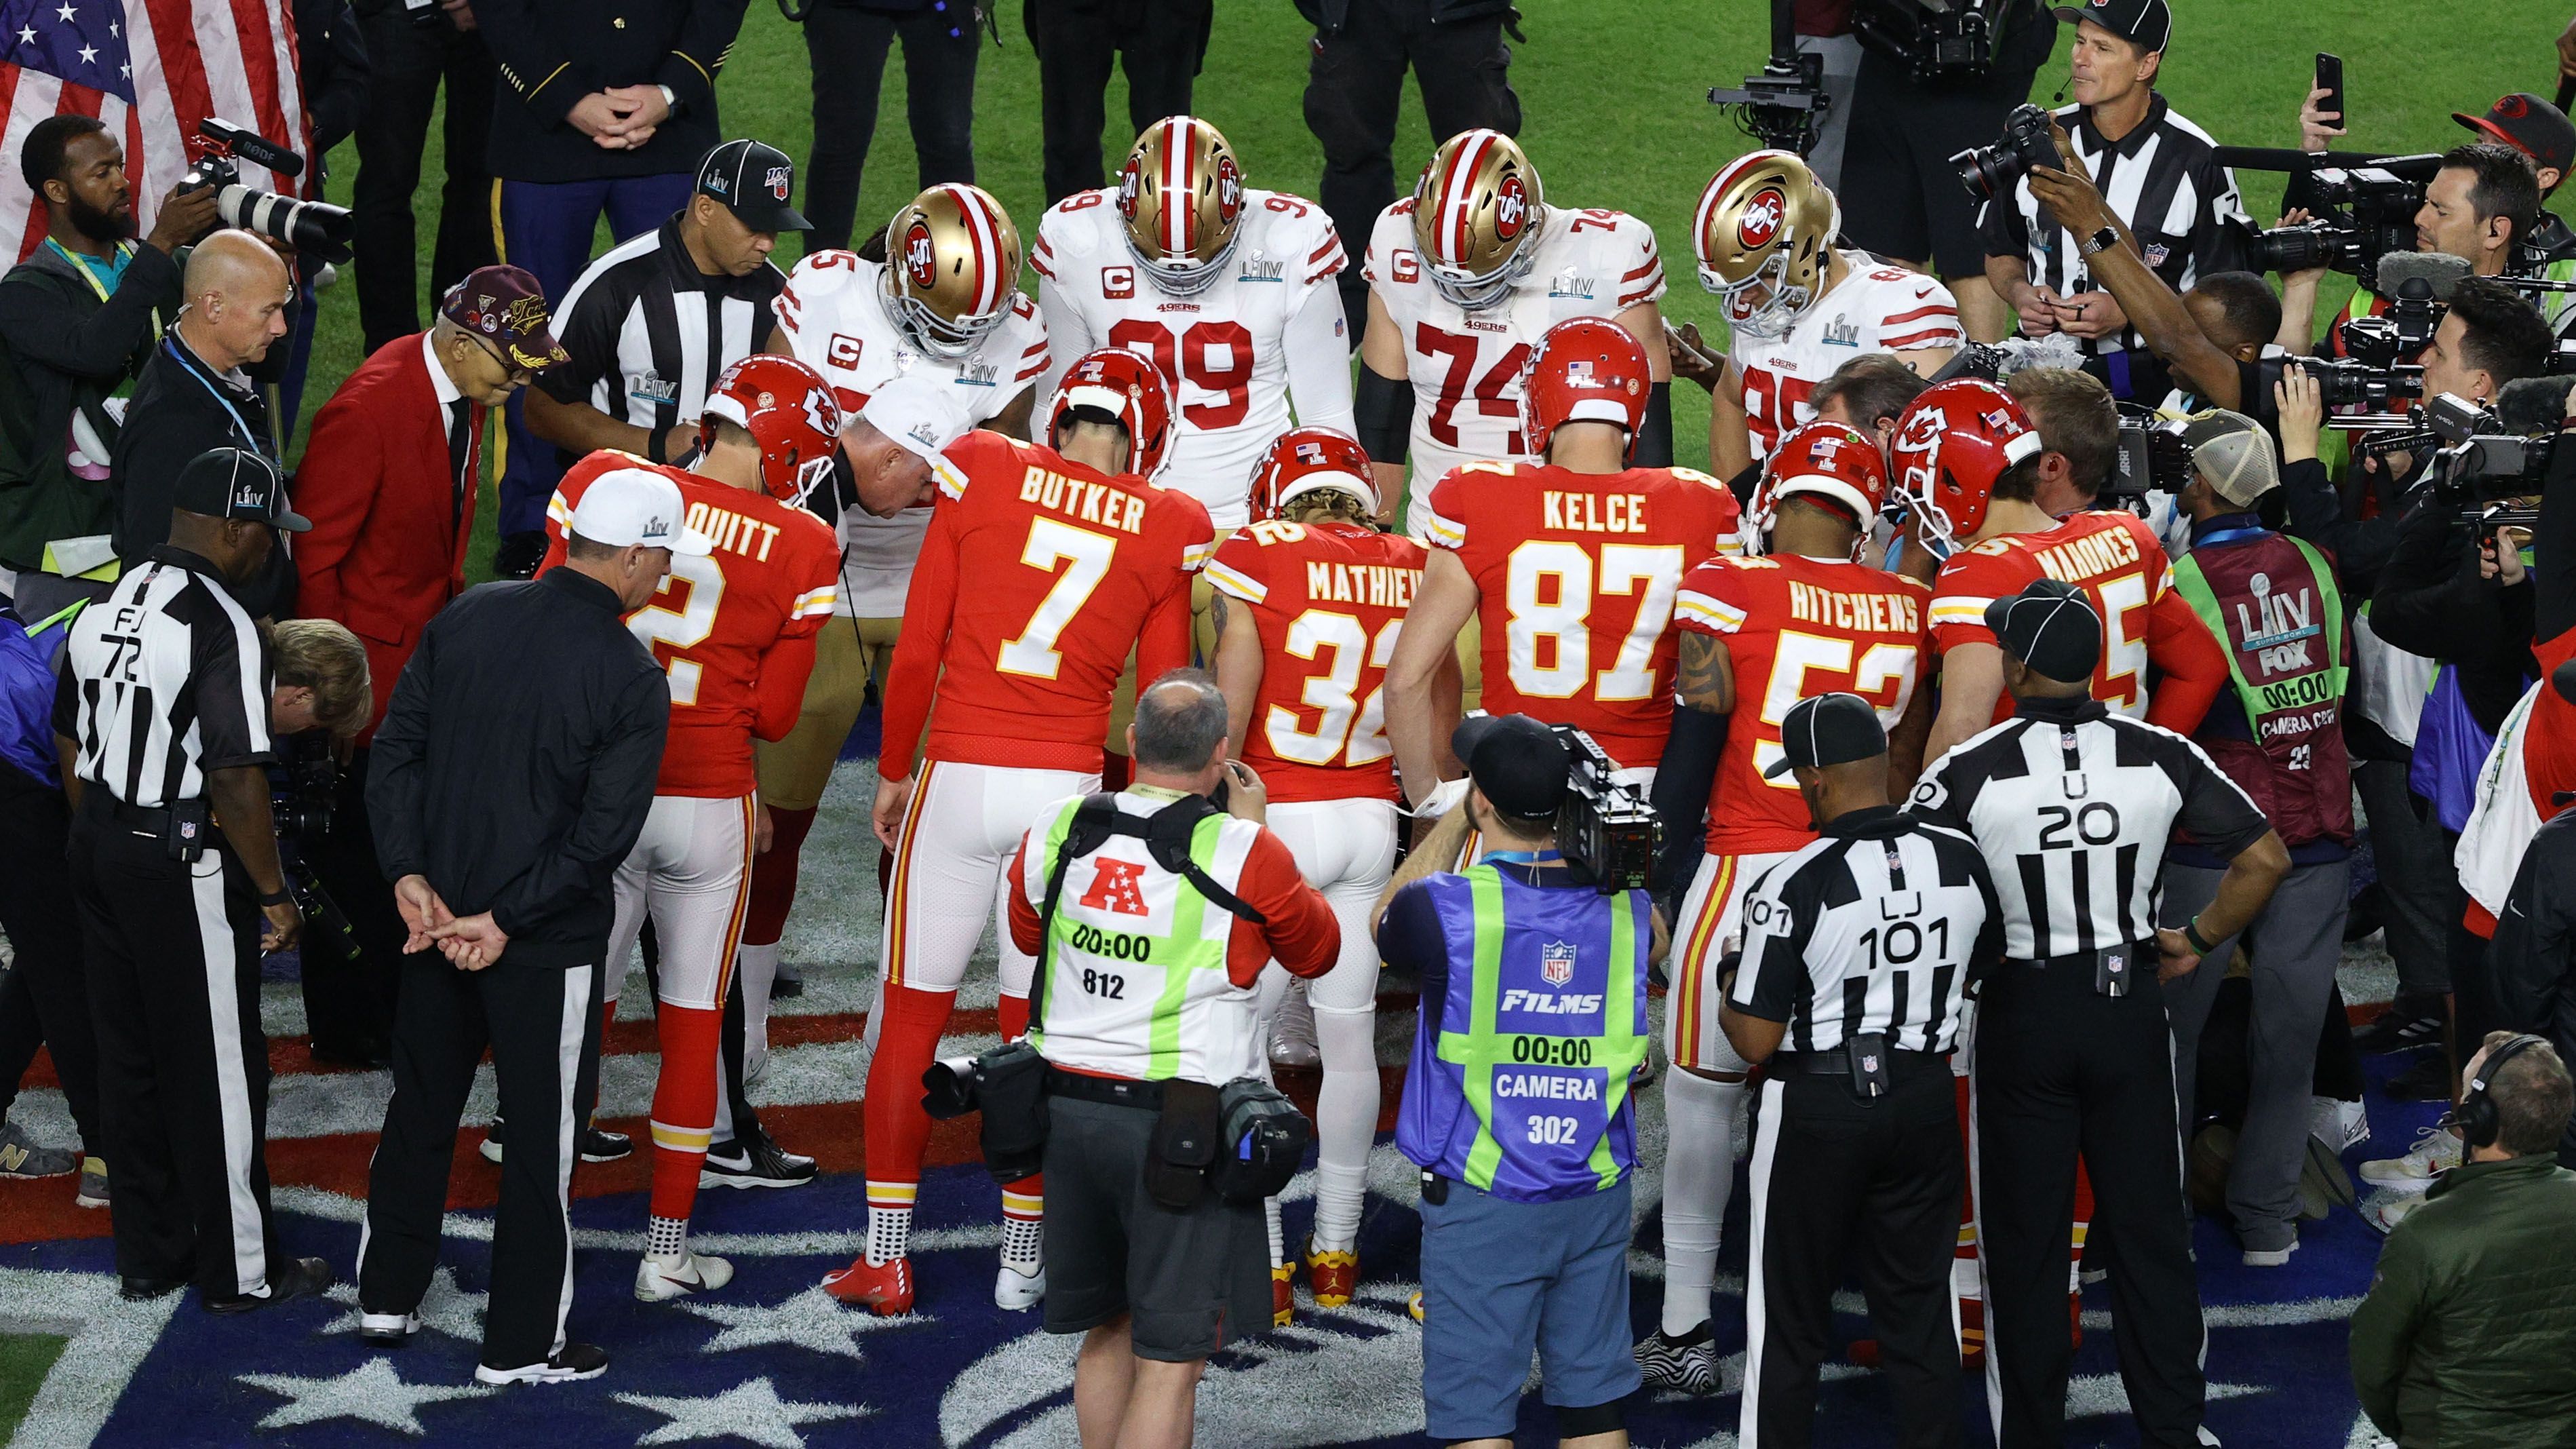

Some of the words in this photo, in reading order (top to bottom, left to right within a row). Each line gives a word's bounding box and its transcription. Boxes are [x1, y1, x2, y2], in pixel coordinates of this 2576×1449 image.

[1104, 269, 1132, 291] C
[1156, 303, 1201, 320] 49ERS
[1464, 320, 1508, 333] 49ERS
[829, 337, 860, 362] C
[1768, 357, 1797, 371] 49ERS
[1019, 465, 1146, 535] BUTKER
[1543, 490, 1647, 533] KELCE
[2034, 525, 2140, 583] MAHOMES
[996, 515, 1118, 680] 7
[1788, 580, 1918, 634] HITCHENS
[115, 608, 147, 632] FJ
[1506, 539, 1685, 701] 87
[100, 634, 142, 682] 72
[2258, 638, 2314, 677] FOX
[2262, 673, 2328, 708] 00:00
[2063, 773, 2088, 800] U
[2037, 801, 2121, 851] 20
[1080, 856, 1149, 916] A
[1746, 897, 1791, 933] 101
[1072, 924, 1151, 963] 00:00
[1859, 916, 1949, 970] 101
[1082, 968, 1125, 1001] 812
[1546, 960, 1571, 984] NFL
[1500, 989, 1603, 1014] FILMS
[1513, 1035, 1592, 1066] 00:00
[1496, 1074, 1598, 1101] CAMERA
[1527, 1115, 1579, 1144] 302
